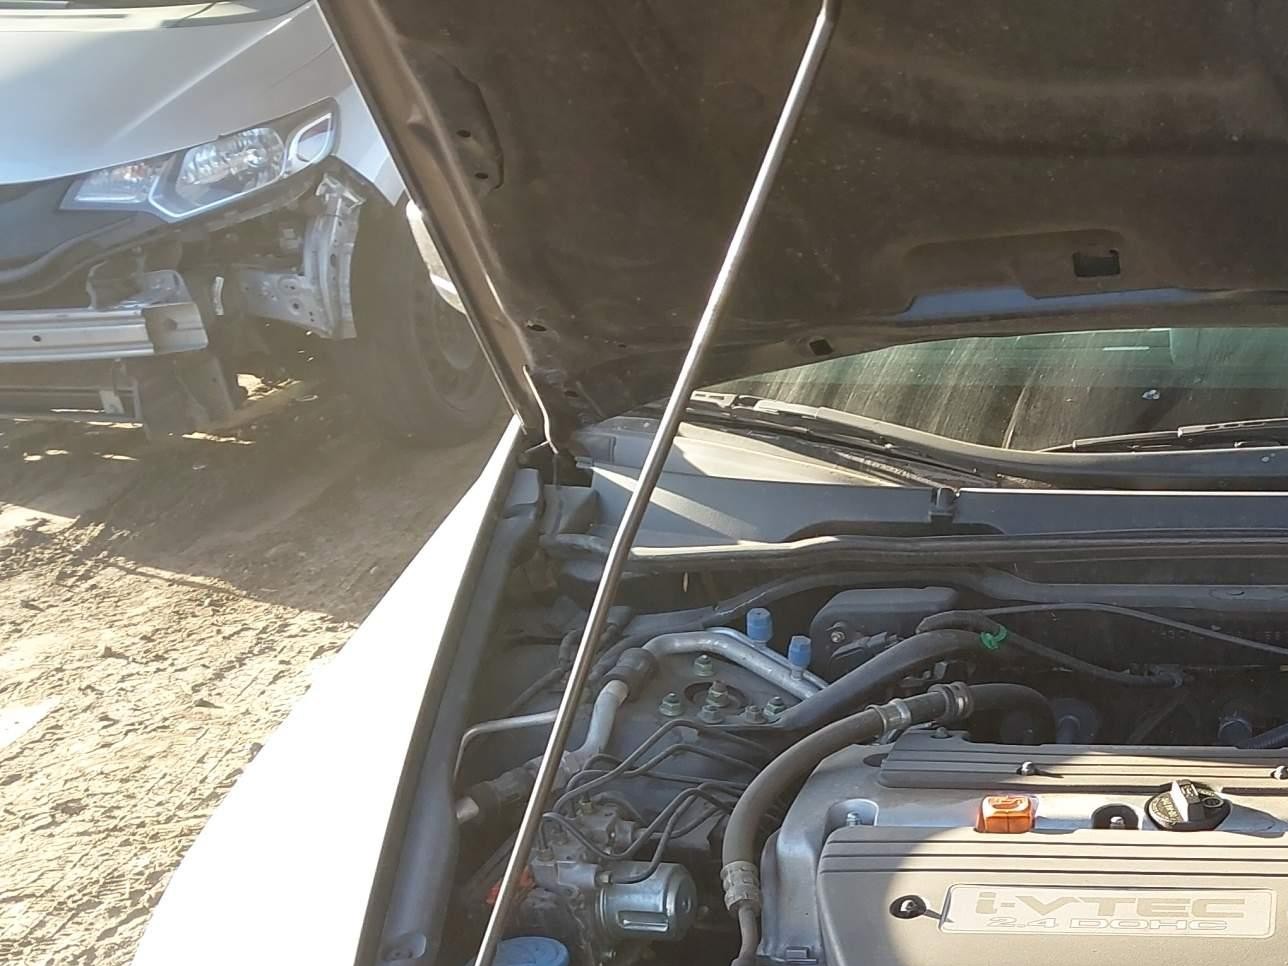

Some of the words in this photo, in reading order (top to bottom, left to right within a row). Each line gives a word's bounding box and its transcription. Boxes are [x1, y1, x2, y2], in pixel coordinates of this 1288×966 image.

[975, 891, 1246, 919] i-VTEC
[986, 916, 1057, 929] 2.4
[1069, 918, 1228, 931] DOHC
